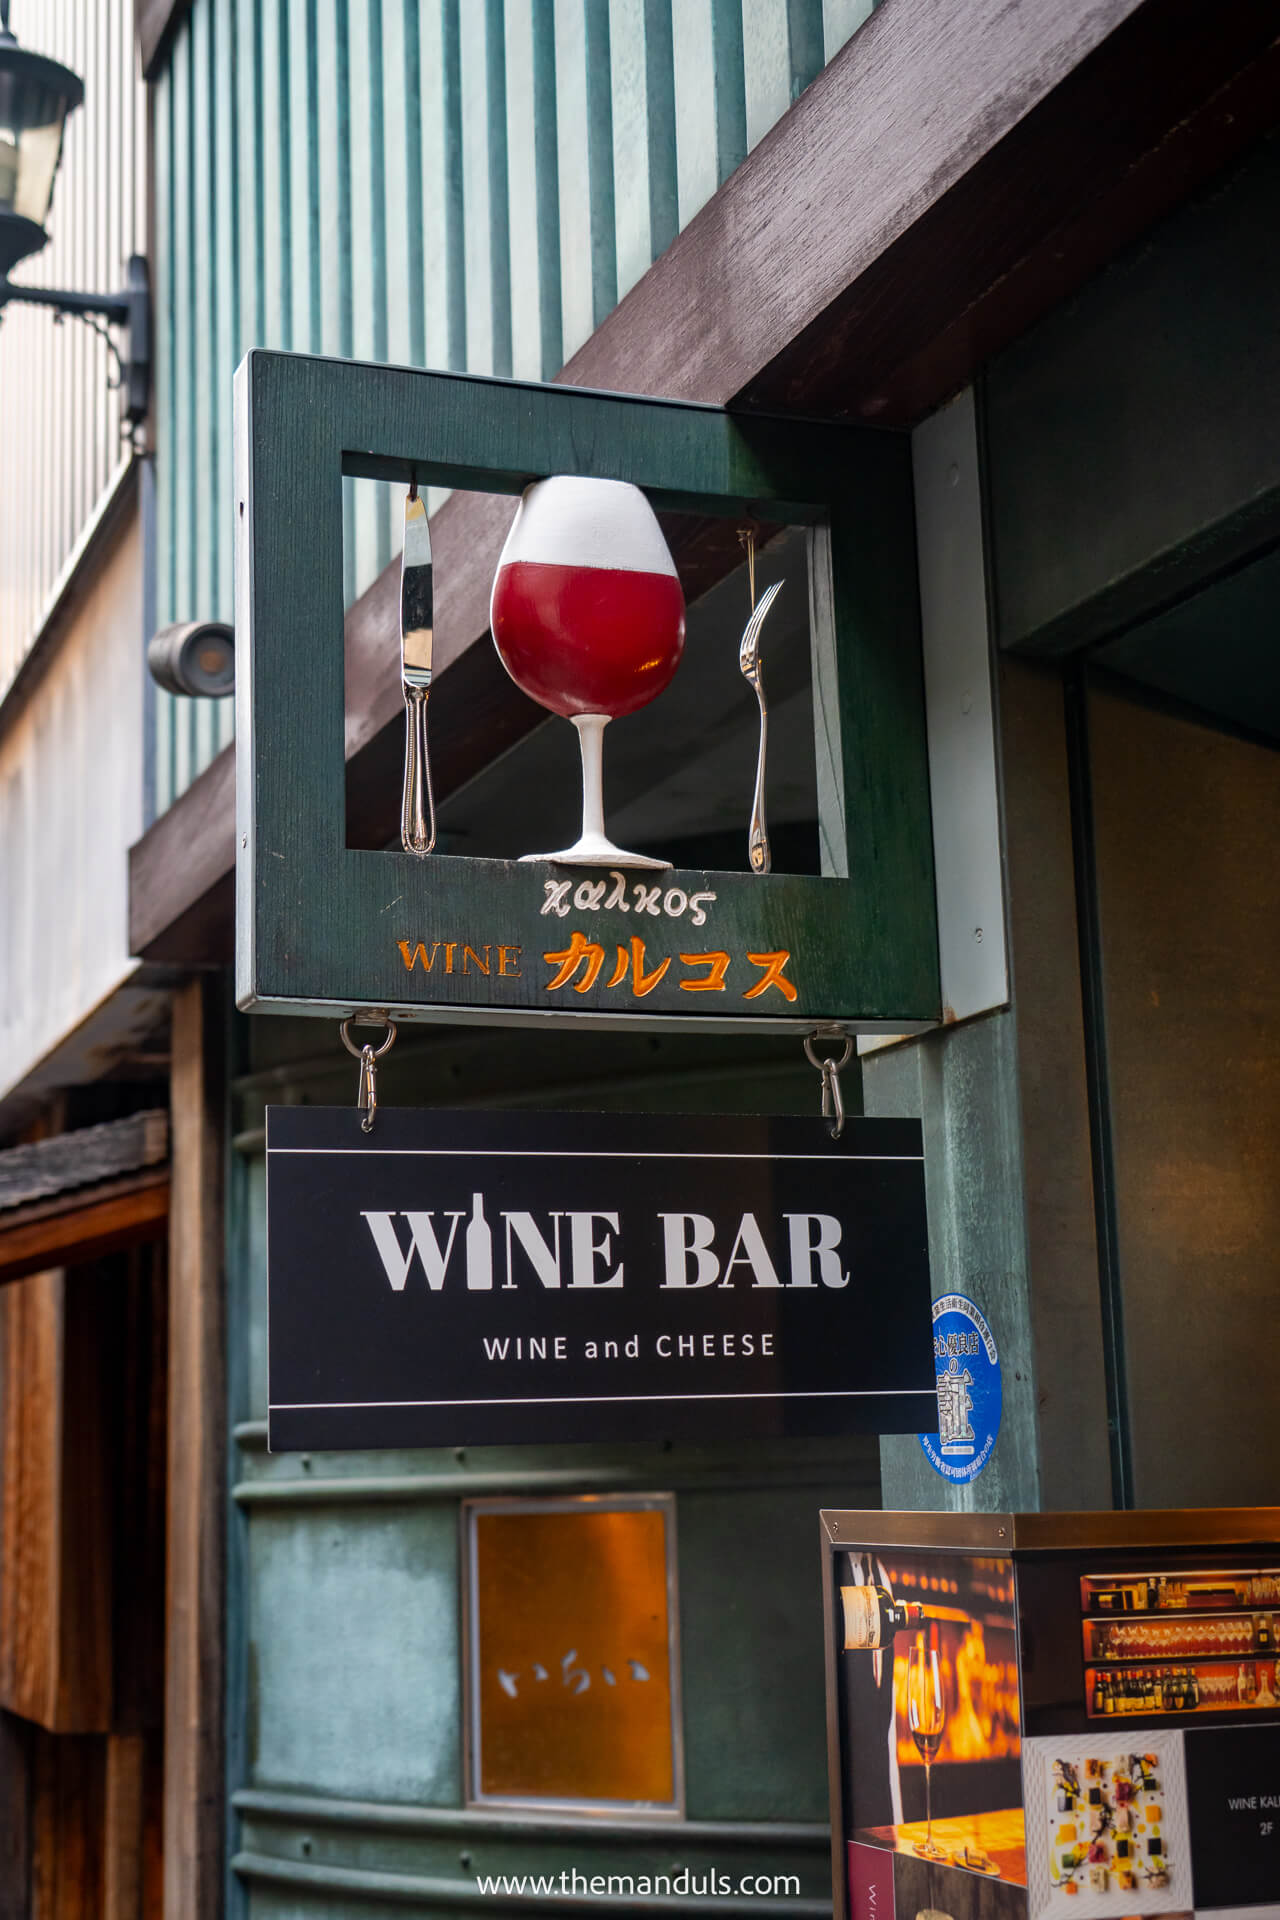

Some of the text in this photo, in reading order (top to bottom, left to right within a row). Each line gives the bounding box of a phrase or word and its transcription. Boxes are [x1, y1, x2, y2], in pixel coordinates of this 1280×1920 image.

[396, 931, 798, 1002] WINE カルコス
[360, 1192, 851, 1291] WINE BAR
[483, 1333, 776, 1361] WINE and CHEESE
[1228, 1797, 1257, 1810] WINE
[1260, 1822, 1273, 1836] 2F
